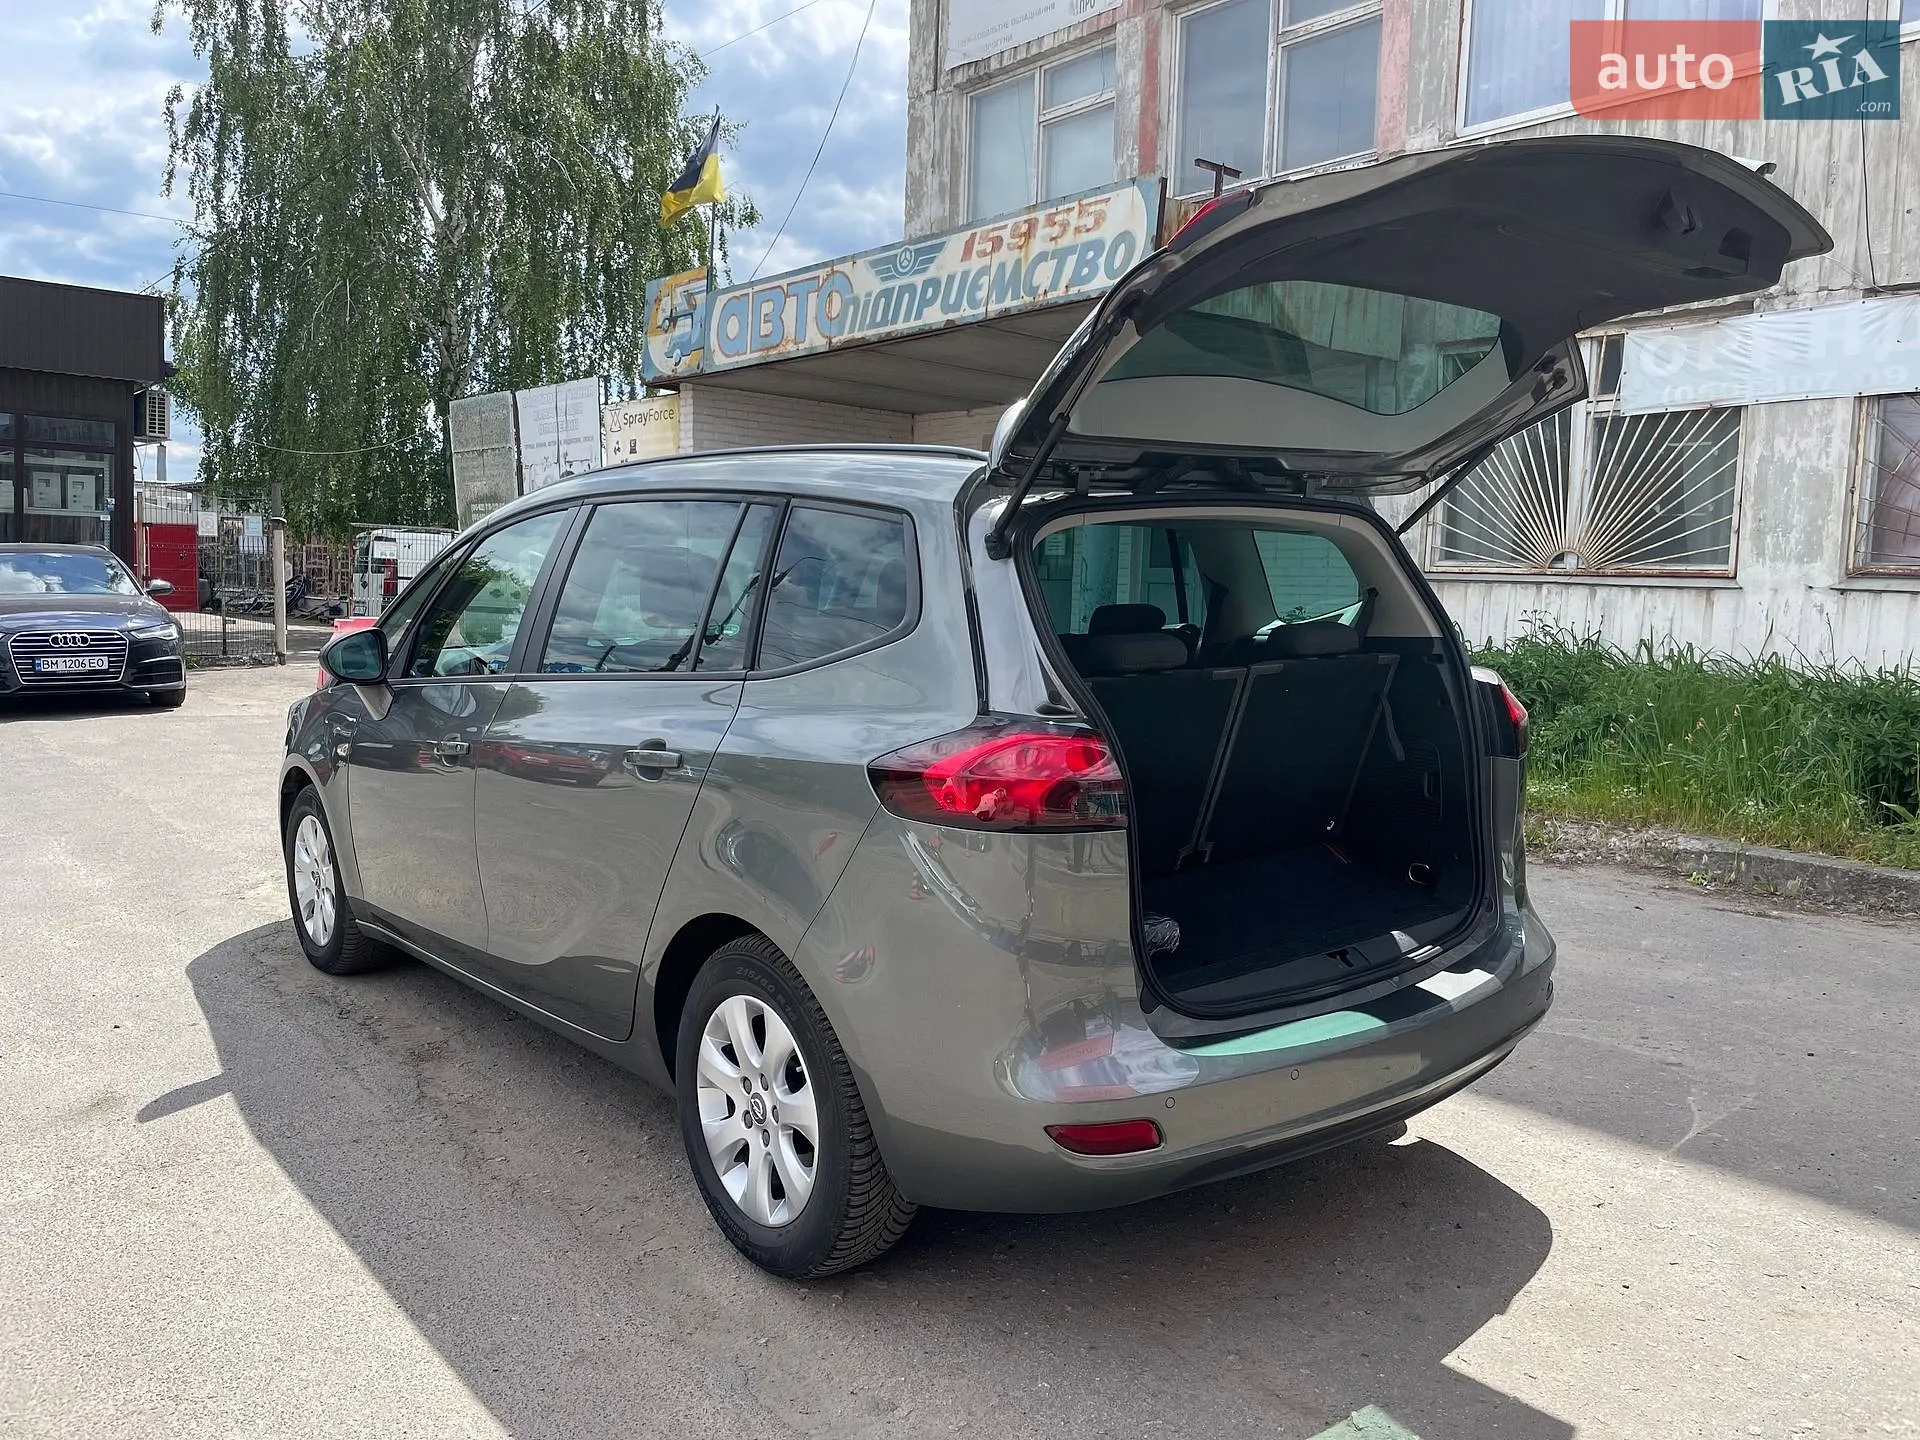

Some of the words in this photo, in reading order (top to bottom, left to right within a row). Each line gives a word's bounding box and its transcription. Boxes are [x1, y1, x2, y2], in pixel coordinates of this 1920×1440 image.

[961, 197, 1112, 263] 15955
[623, 408, 675, 428] SprayForce
[42, 660, 59, 670] BM
[62, 659, 87, 669] 1206
[88, 658, 104, 668] EO
